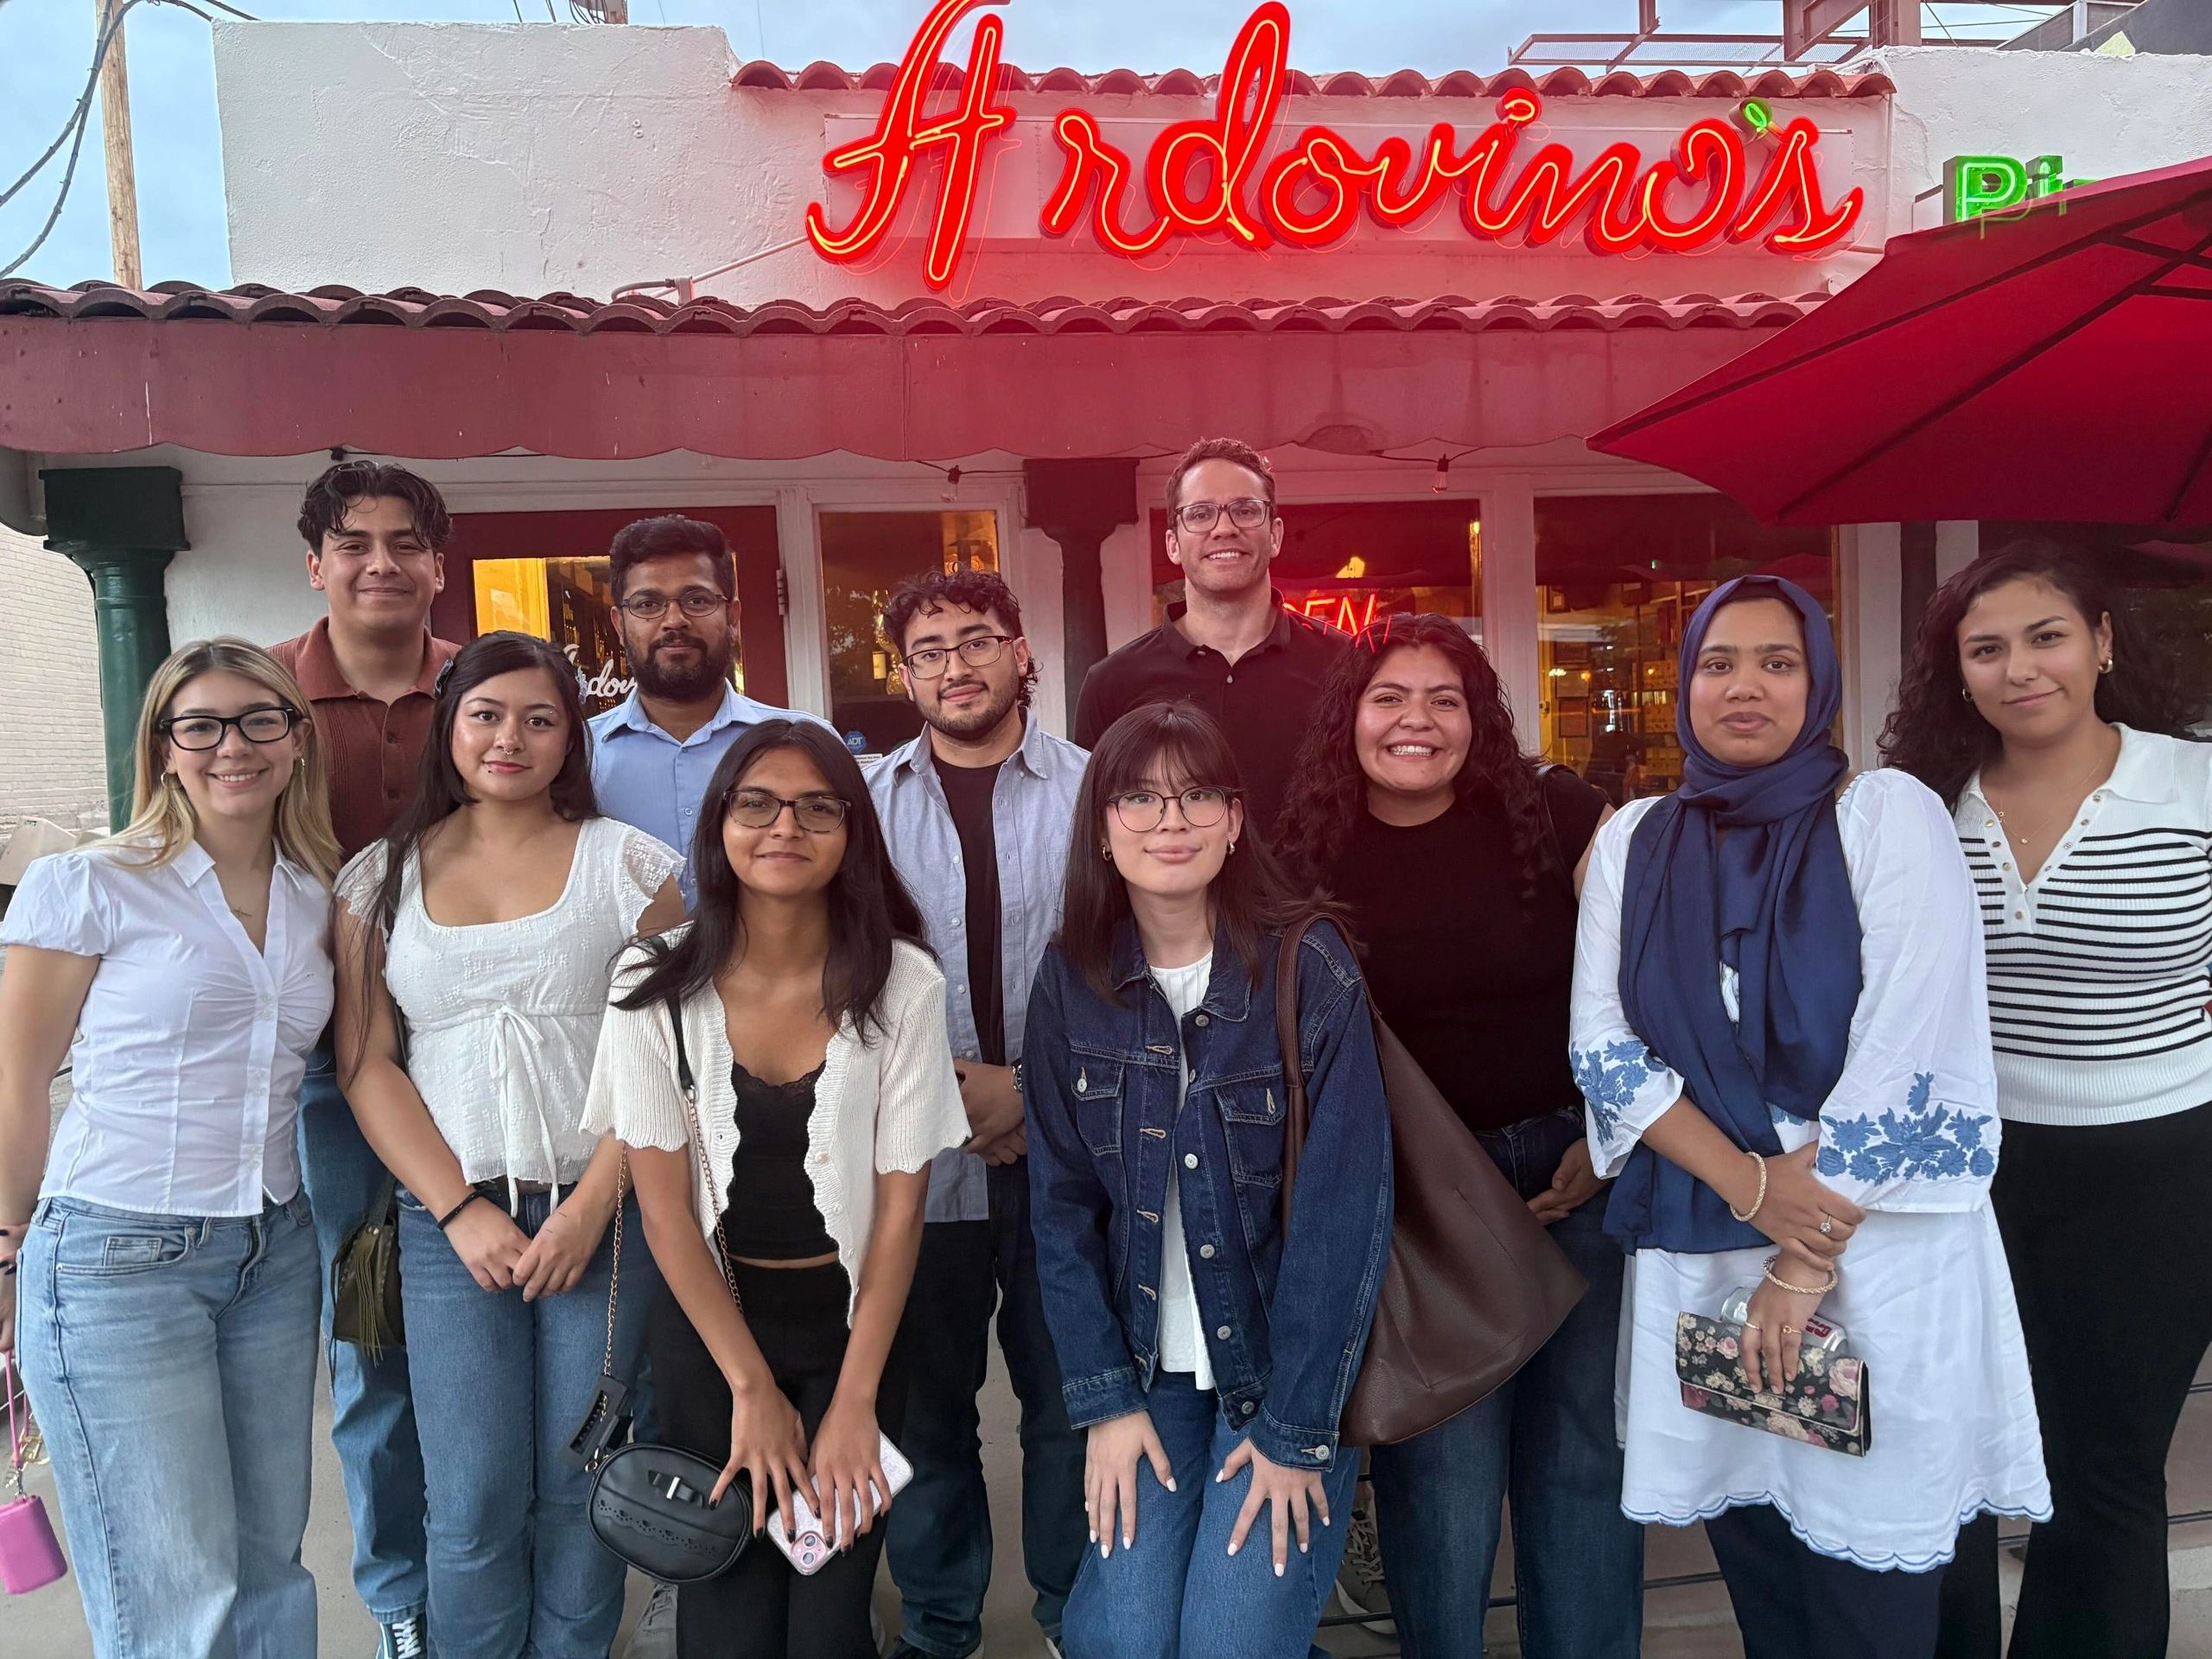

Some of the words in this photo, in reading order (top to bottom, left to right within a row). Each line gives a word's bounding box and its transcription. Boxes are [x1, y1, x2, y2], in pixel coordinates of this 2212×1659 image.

[805, 0, 1864, 290] Ardovino's
[1942, 155, 2100, 222] Pi
[1283, 594, 1376, 636] EN
[847, 736, 862, 746] ADT
